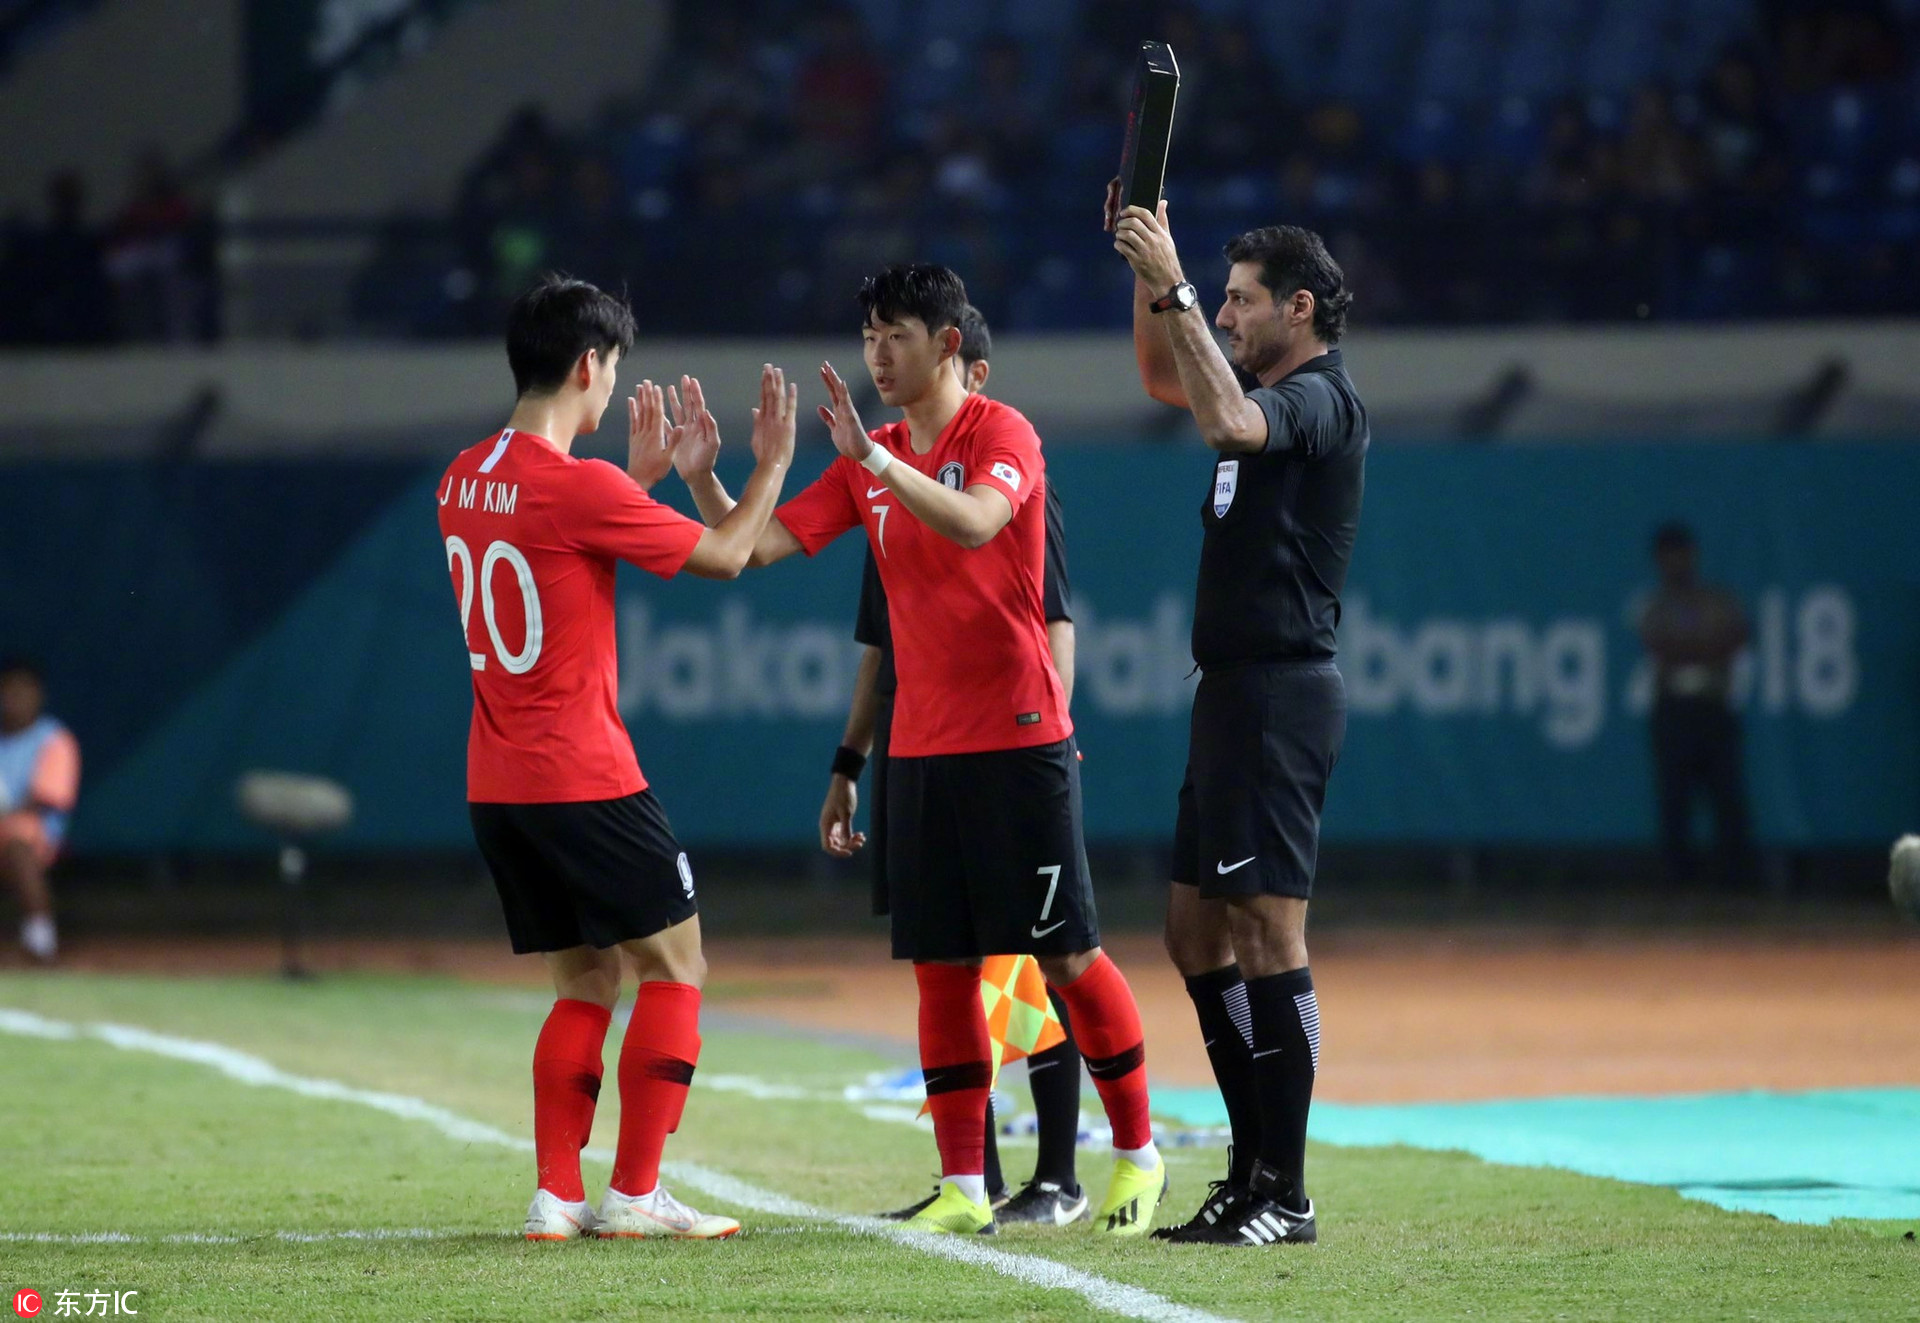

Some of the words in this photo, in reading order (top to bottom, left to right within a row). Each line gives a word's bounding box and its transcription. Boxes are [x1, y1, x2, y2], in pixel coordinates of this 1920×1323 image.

[440, 475, 452, 506] J
[458, 478, 477, 509] M
[483, 482, 518, 515] KIM
[872, 505, 890, 559] 7
[446, 535, 543, 675] 20
[620, 594, 868, 715] Jaka
[1037, 865, 1061, 921] 7
